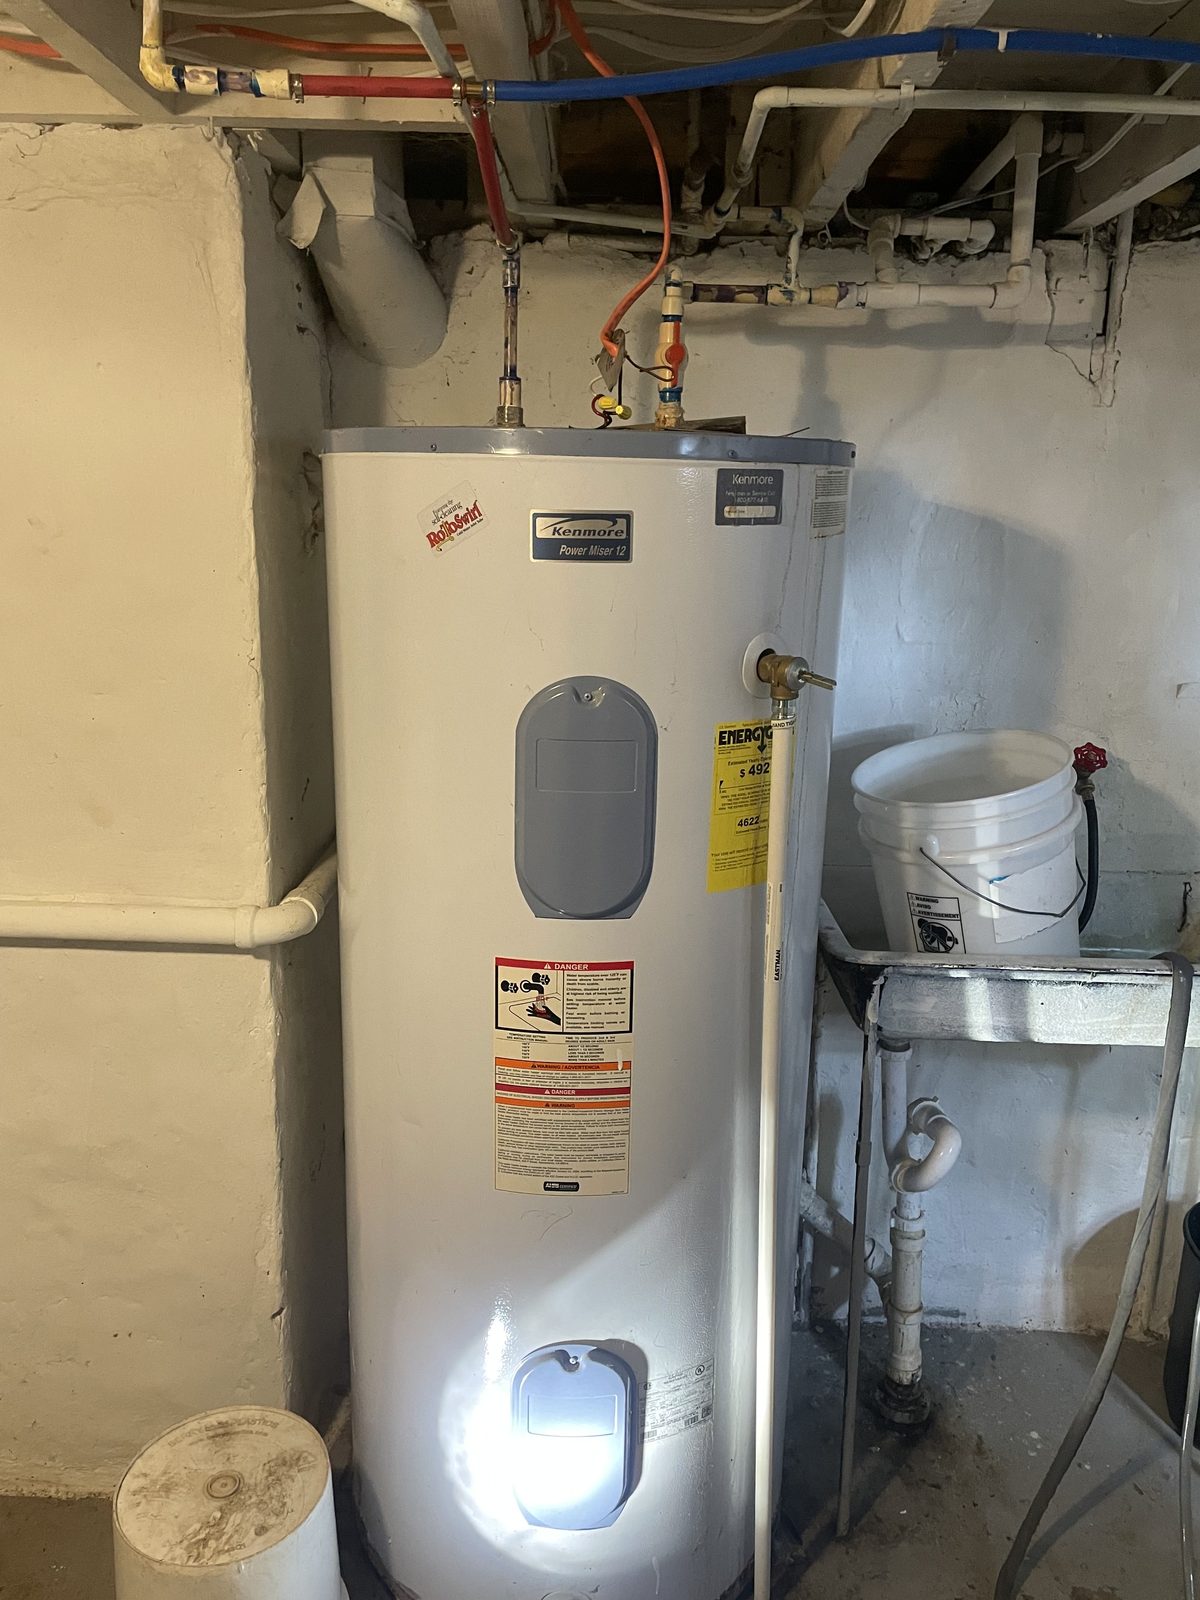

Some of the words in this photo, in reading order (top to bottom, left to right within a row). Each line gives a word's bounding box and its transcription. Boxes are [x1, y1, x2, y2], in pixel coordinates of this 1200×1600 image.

[732, 474, 774, 485] Kenmore
[552, 527, 624, 537] Kenmore
[560, 545, 588, 556] Power
[589, 545, 614, 556] Miser
[616, 546, 626, 556] 12
[748, 762, 770, 776] 492
[737, 815, 760, 827] 4622
[918, 910, 959, 918] AVERTISSEMENT
[554, 963, 589, 971] DANGER
